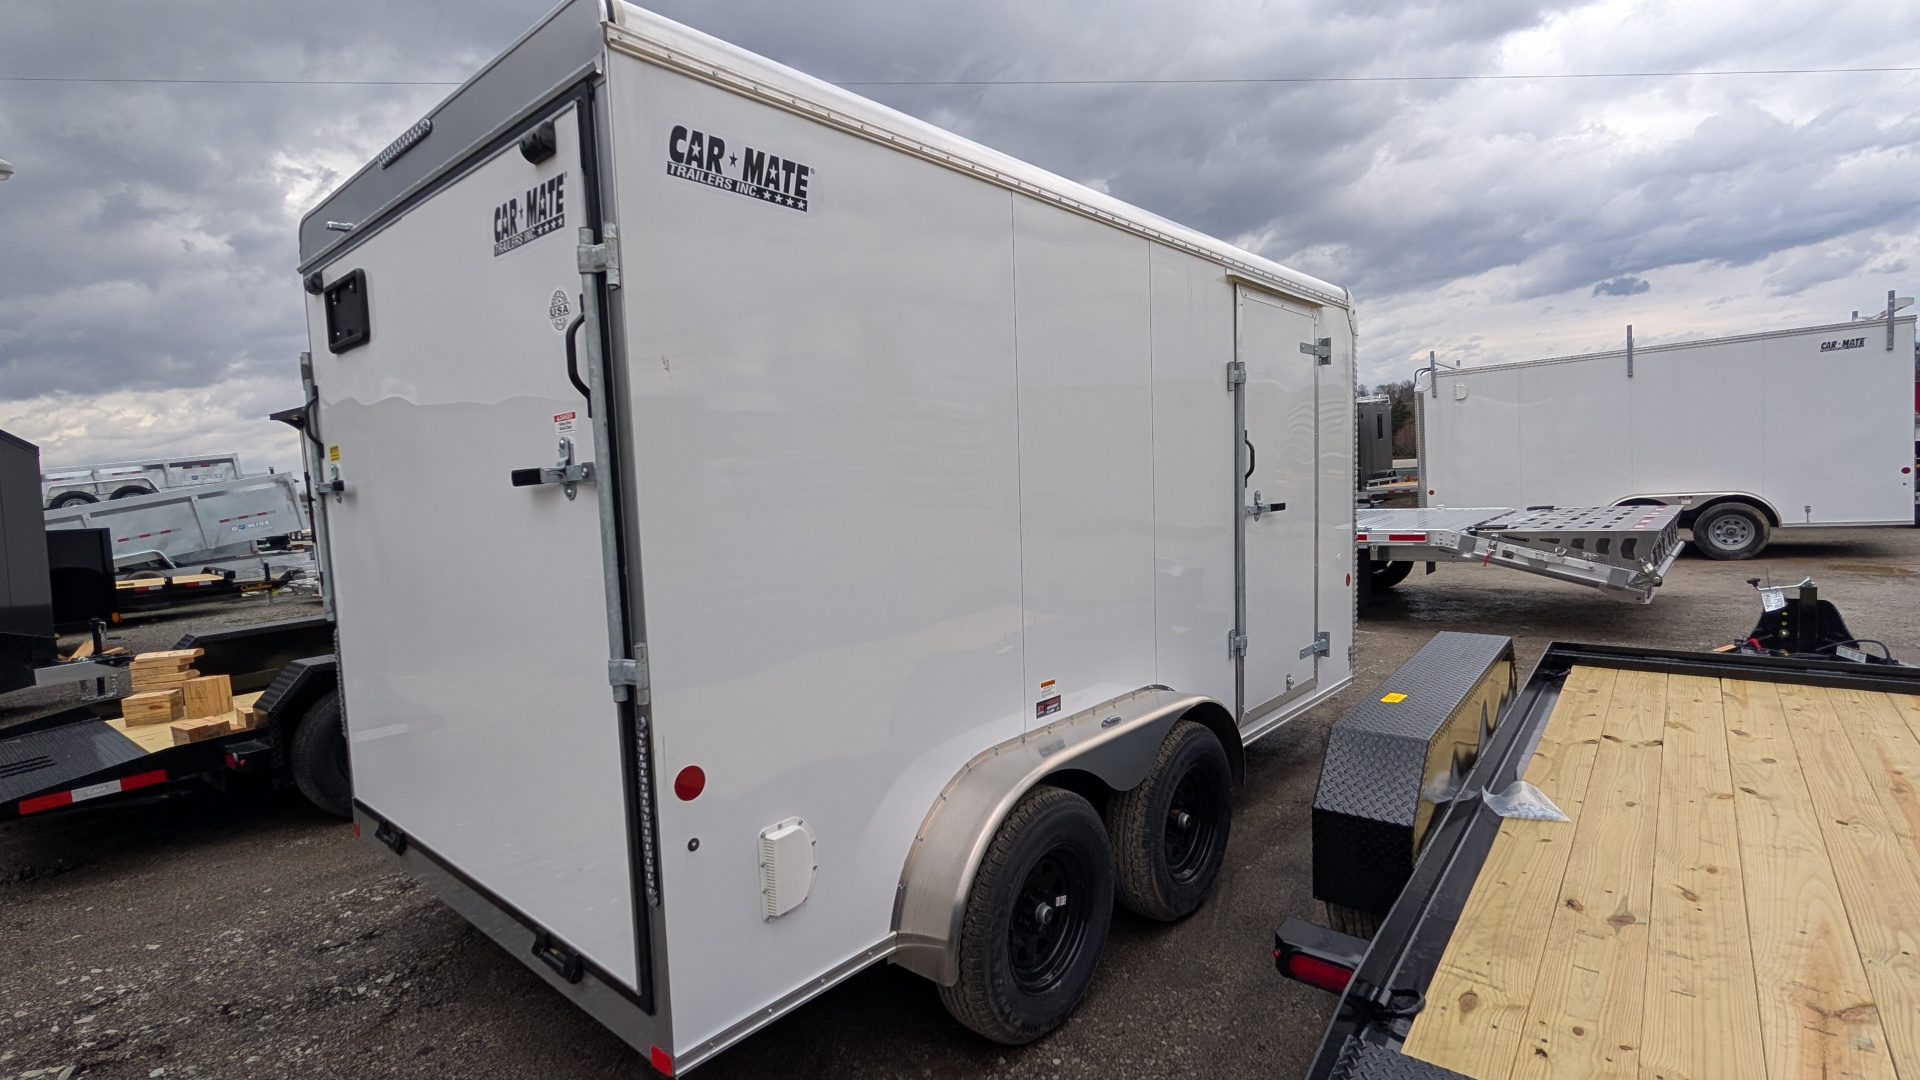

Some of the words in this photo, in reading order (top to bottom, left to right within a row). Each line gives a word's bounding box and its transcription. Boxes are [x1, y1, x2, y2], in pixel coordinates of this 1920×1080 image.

[669, 124, 726, 175] CAR
[742, 146, 810, 199] MATE
[669, 162, 733, 190] TRAILERS
[735, 180, 760, 198] INC.
[494, 197, 518, 243] CAR
[526, 172, 564, 228] MATE
[550, 304, 569, 317] USA
